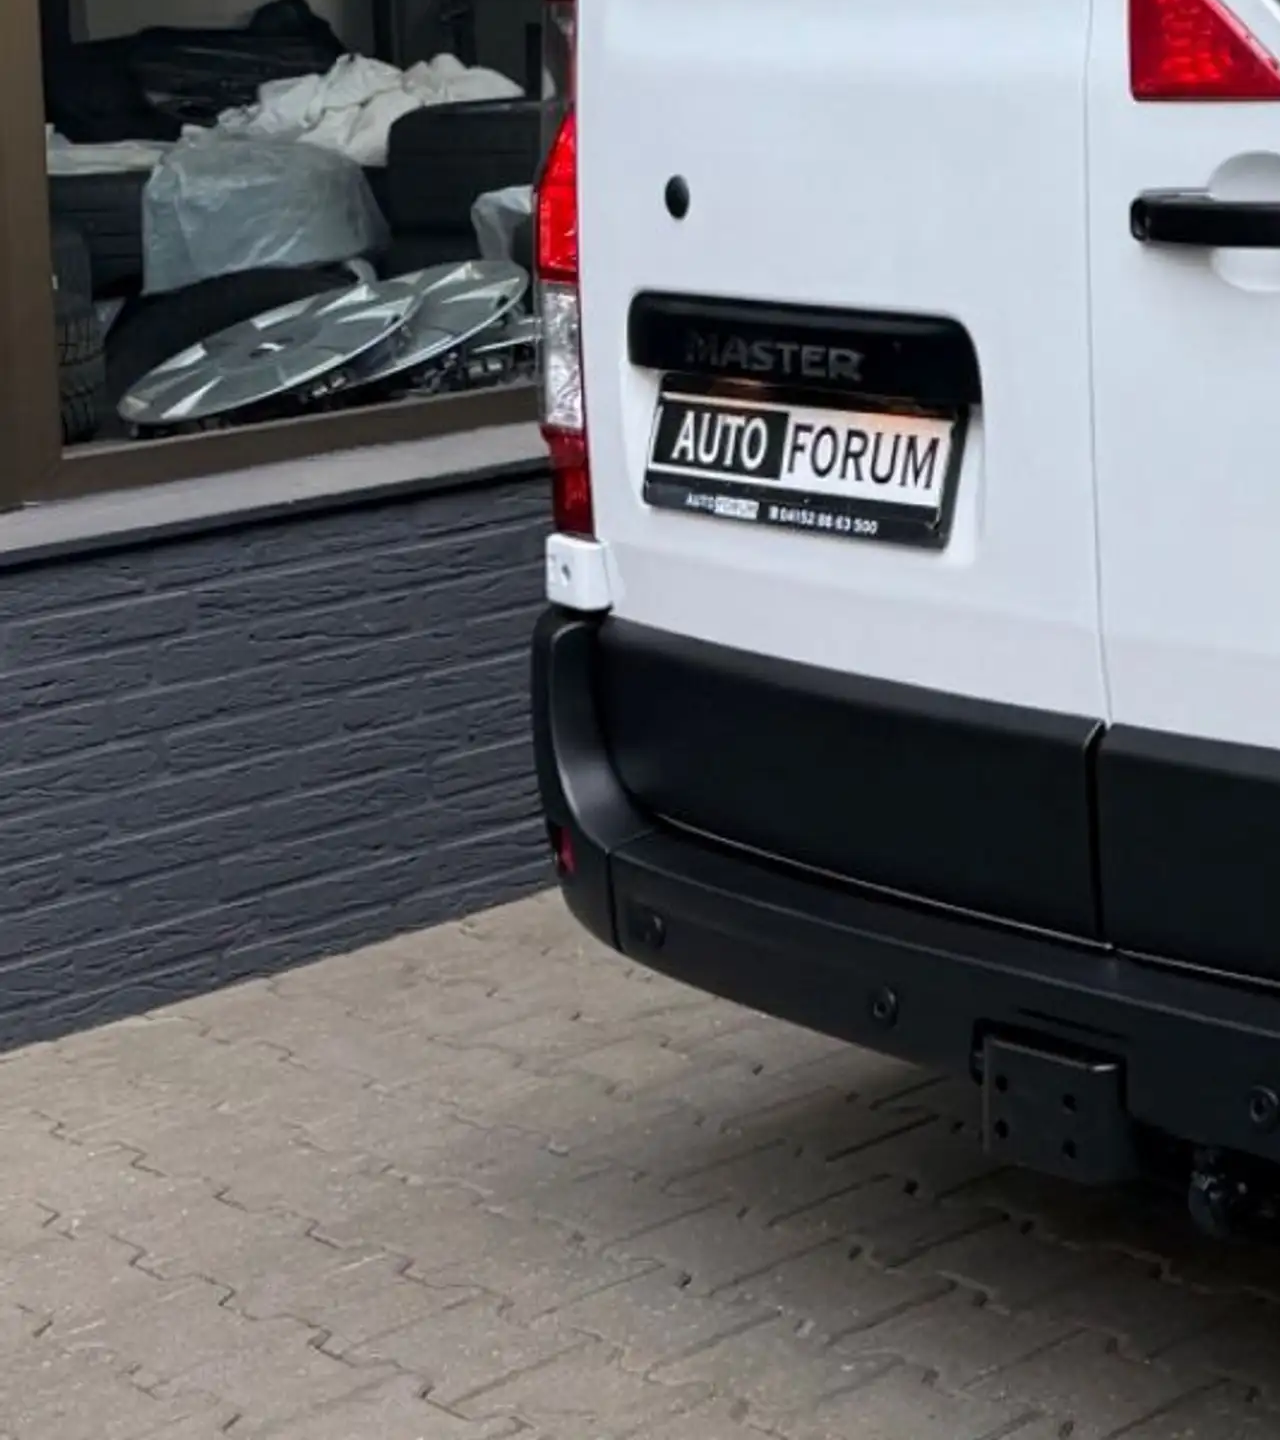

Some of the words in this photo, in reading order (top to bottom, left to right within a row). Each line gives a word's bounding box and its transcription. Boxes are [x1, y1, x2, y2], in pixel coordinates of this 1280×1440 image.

[684, 328, 866, 382] MASTER
[671, 410, 768, 471] AUTO
[786, 422, 941, 490] FORUM
